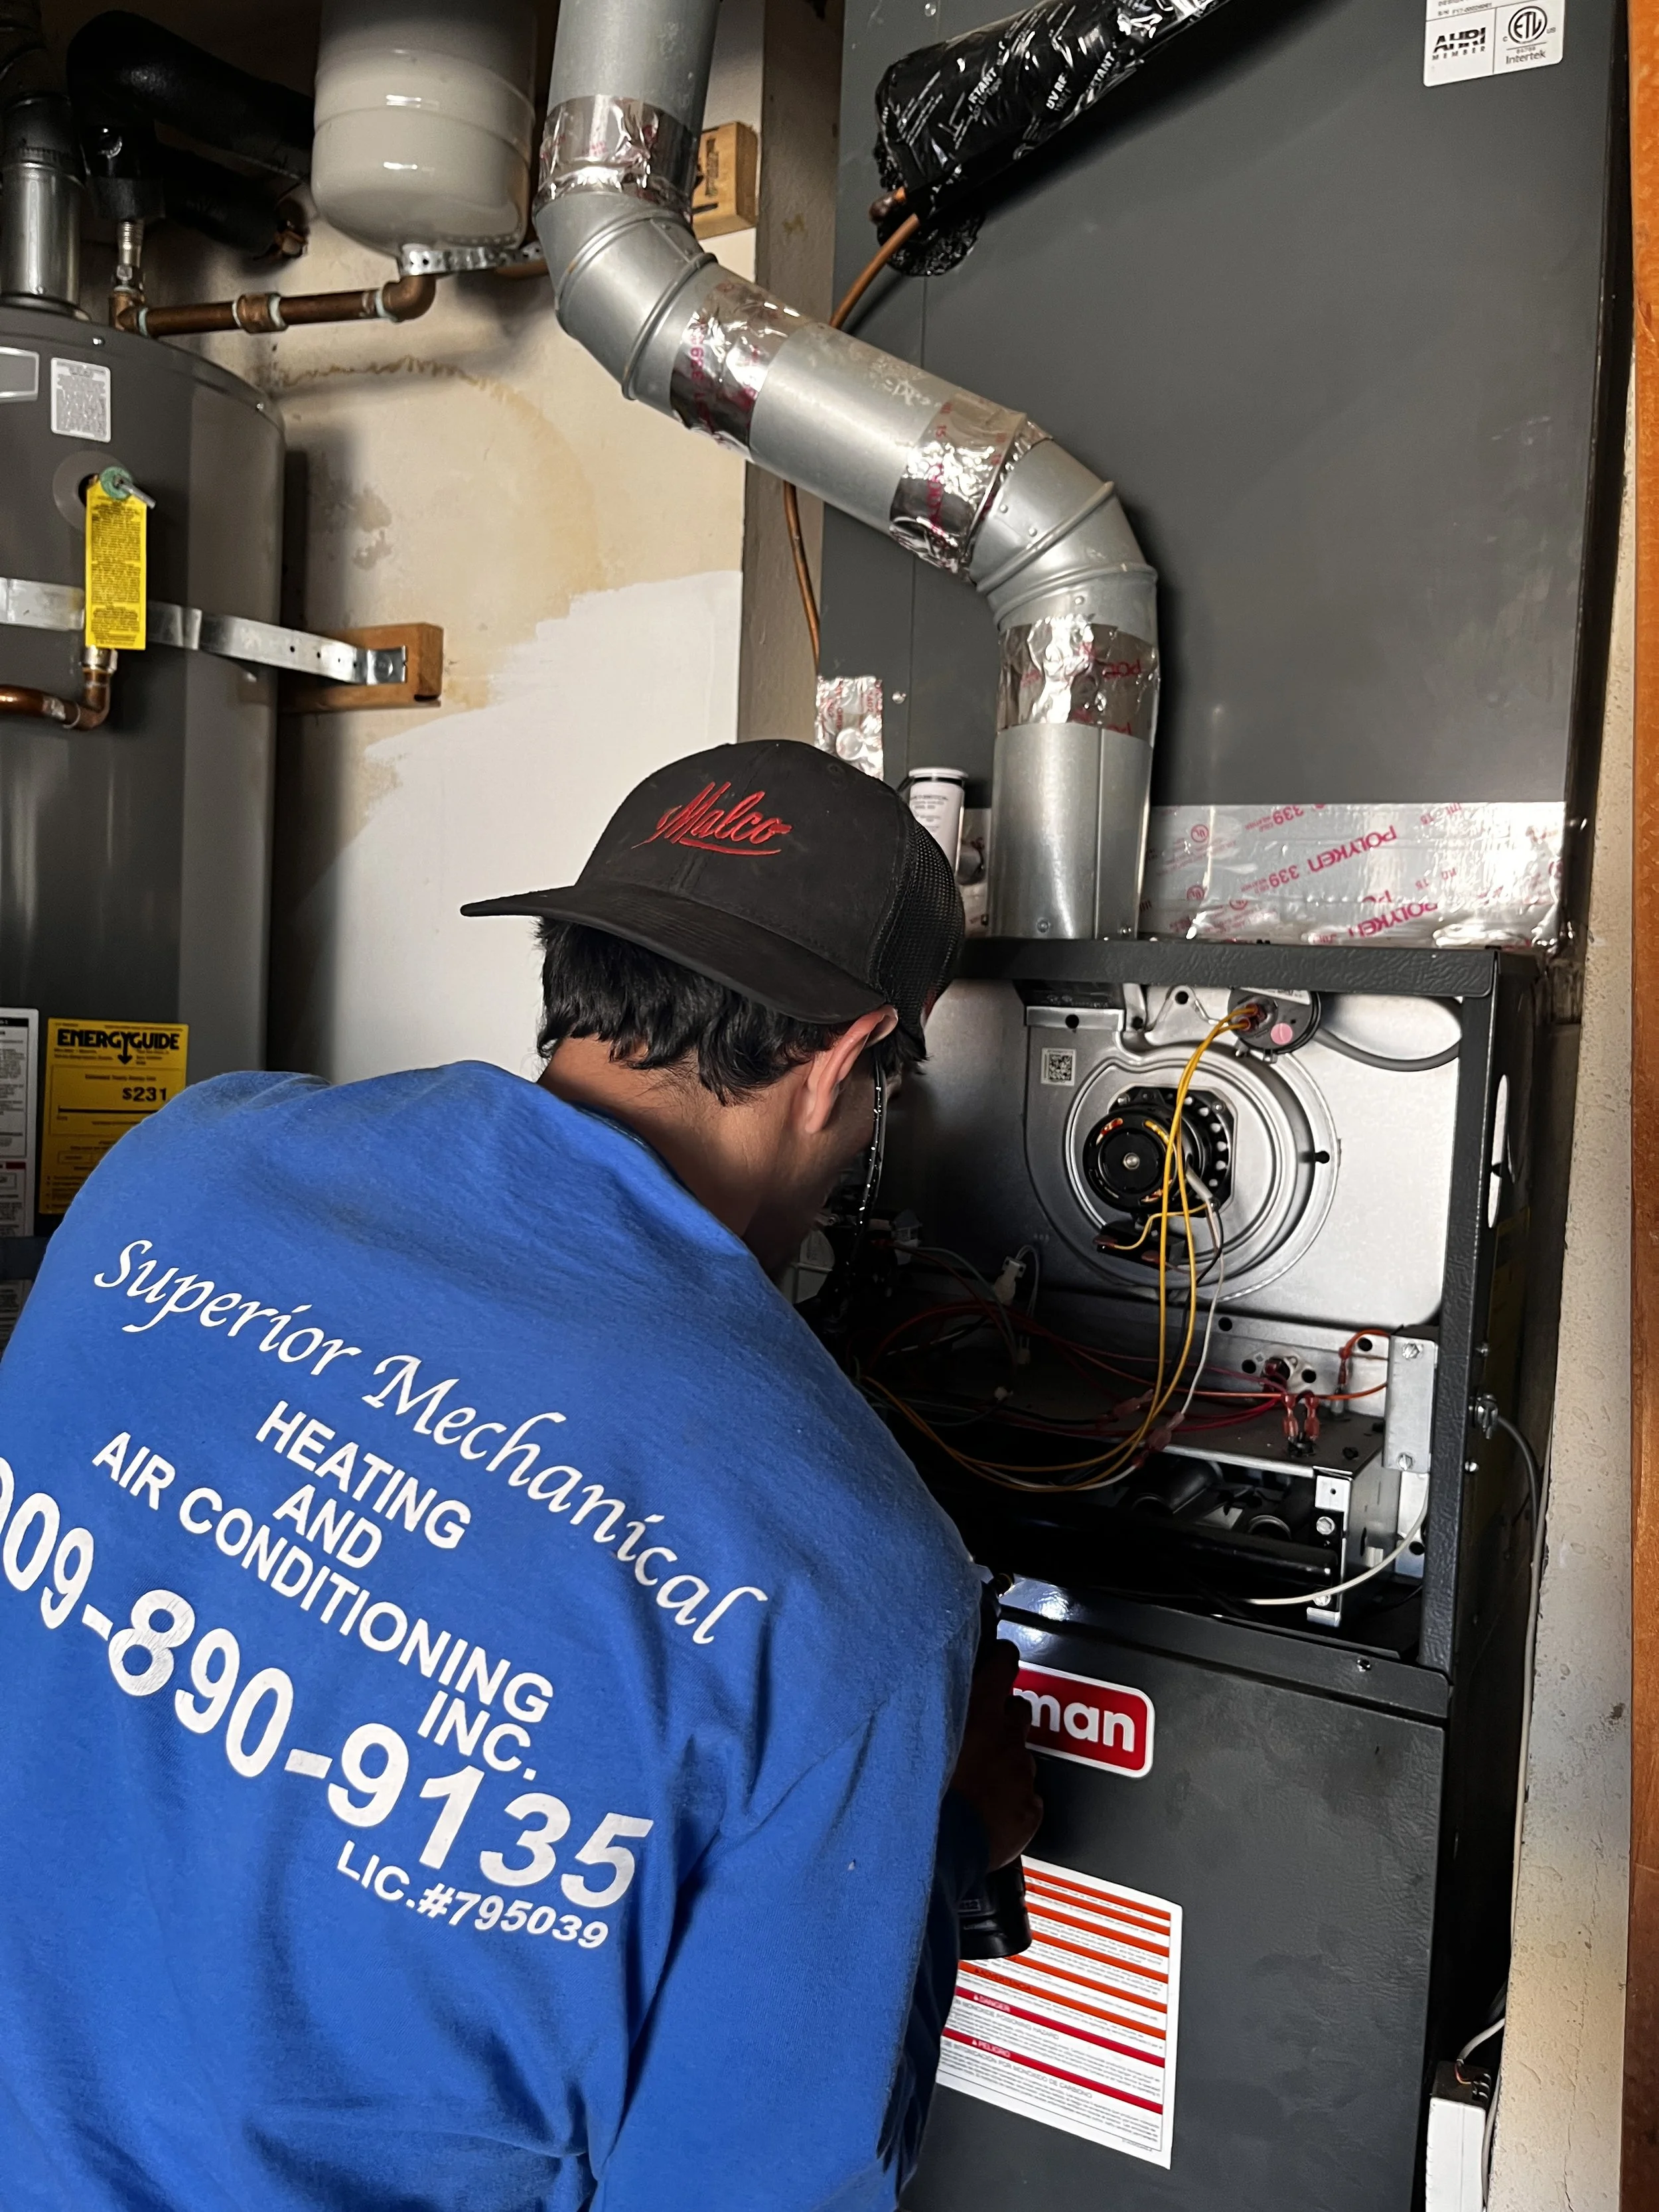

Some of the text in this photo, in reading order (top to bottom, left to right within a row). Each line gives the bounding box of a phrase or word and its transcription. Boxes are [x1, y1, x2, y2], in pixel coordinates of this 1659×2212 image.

[1432, 46, 1486, 60] MEMBER
[1506, 50, 1546, 64] Intertek
[631, 781, 793, 855] Malco
[1268, 825, 1398, 888] POLYKEN 339
[57, 1029, 180, 1050] ENERGYGUIDE
[122, 1087, 167, 1102] $231
[94, 1240, 768, 1644] Superior Mechanical
[255, 1401, 470, 1548] HEATING
[273, 1485, 382, 1568] AND
[92, 1432, 553, 1722] AIR CONDITIONING
[0, 1457, 653, 1908] 09-890-9135
[417, 1690, 538, 1781] INC.
[1013, 1688, 1135, 1753] man
